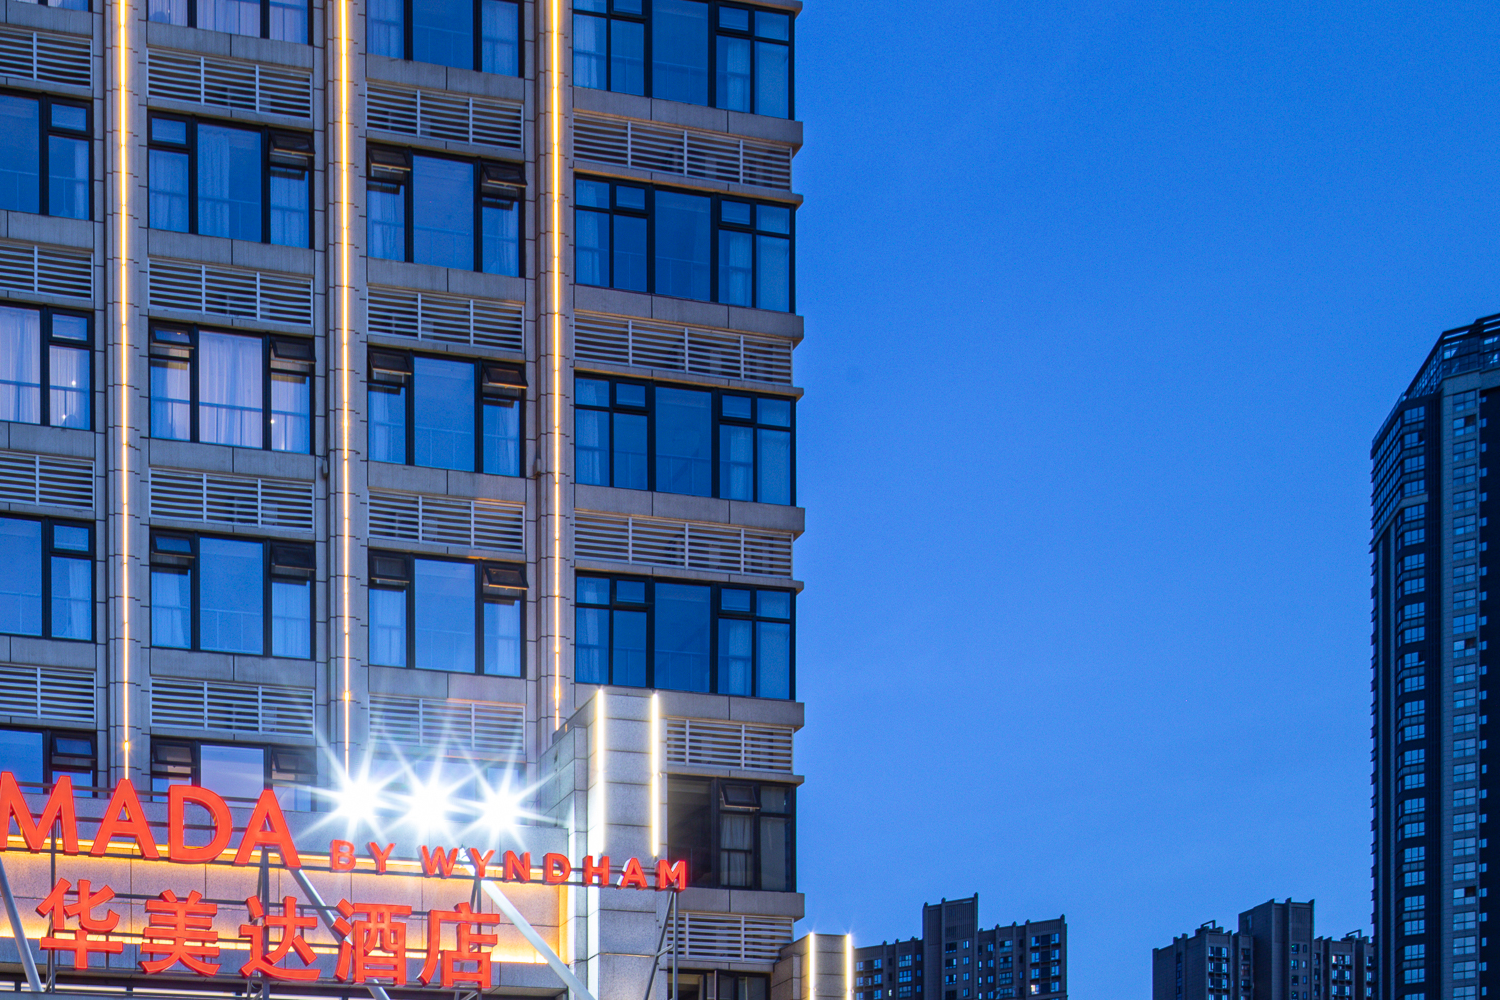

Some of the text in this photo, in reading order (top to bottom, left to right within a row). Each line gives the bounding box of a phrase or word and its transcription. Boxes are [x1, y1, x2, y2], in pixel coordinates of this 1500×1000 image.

[329, 839, 397, 875] BY
[417, 844, 687, 893] WYNDHAM
[36, 877, 500, 990] 华美达酒店
